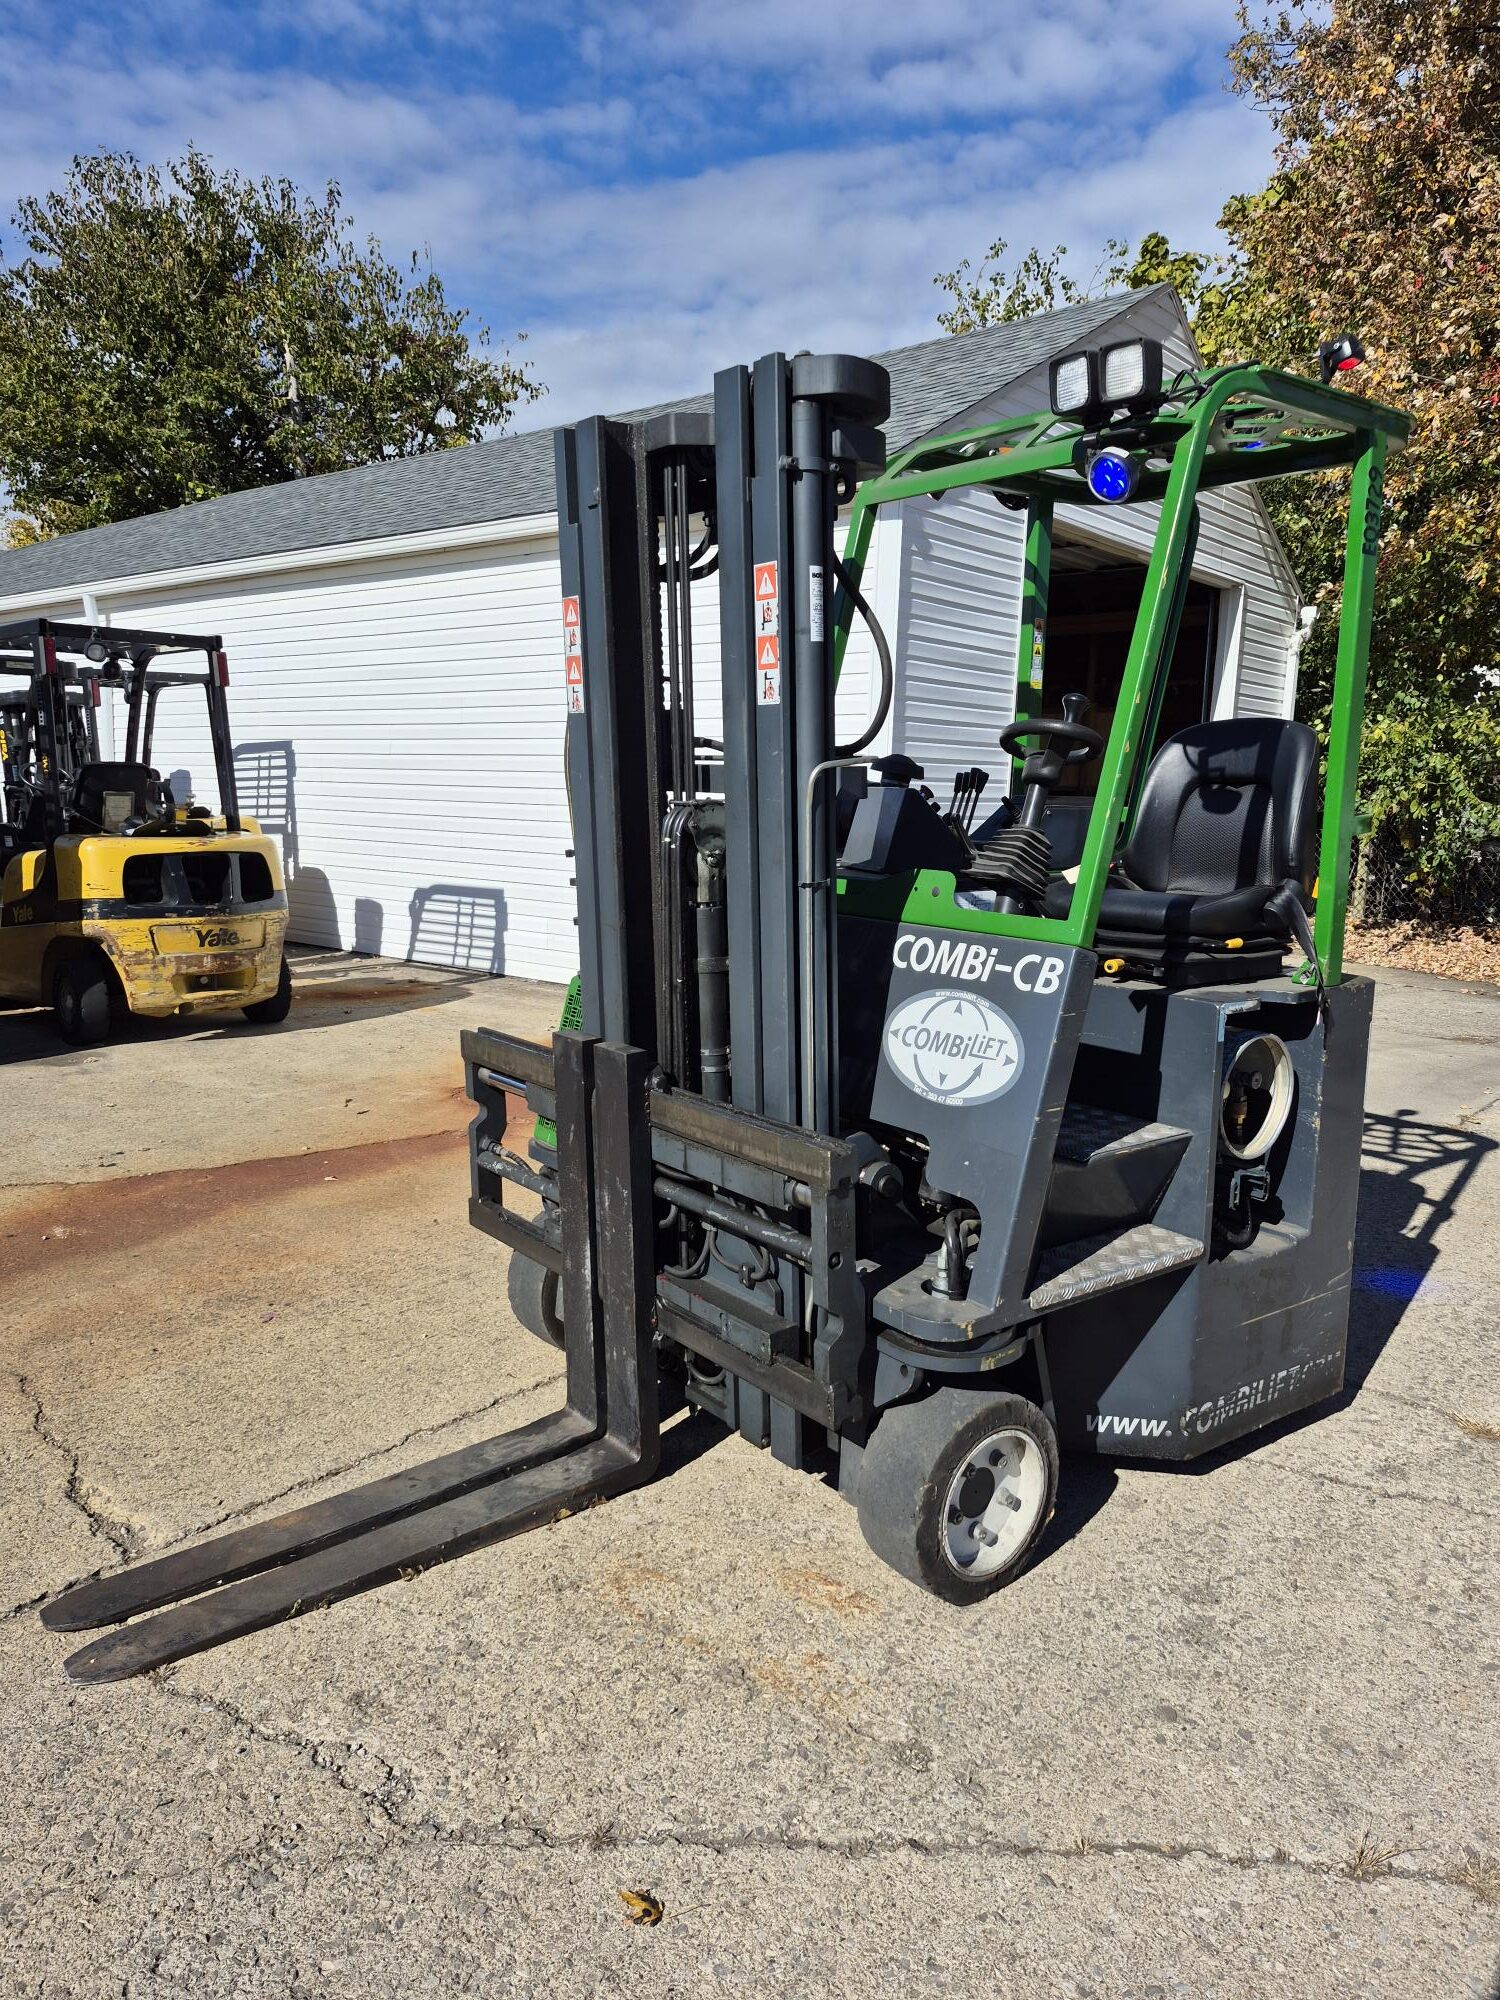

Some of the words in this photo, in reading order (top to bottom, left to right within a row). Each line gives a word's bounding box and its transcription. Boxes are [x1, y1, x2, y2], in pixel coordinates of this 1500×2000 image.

[12, 904, 33, 923] Yale
[195, 928, 240, 947] Yale
[892, 934, 1065, 994] COMBi-CB
